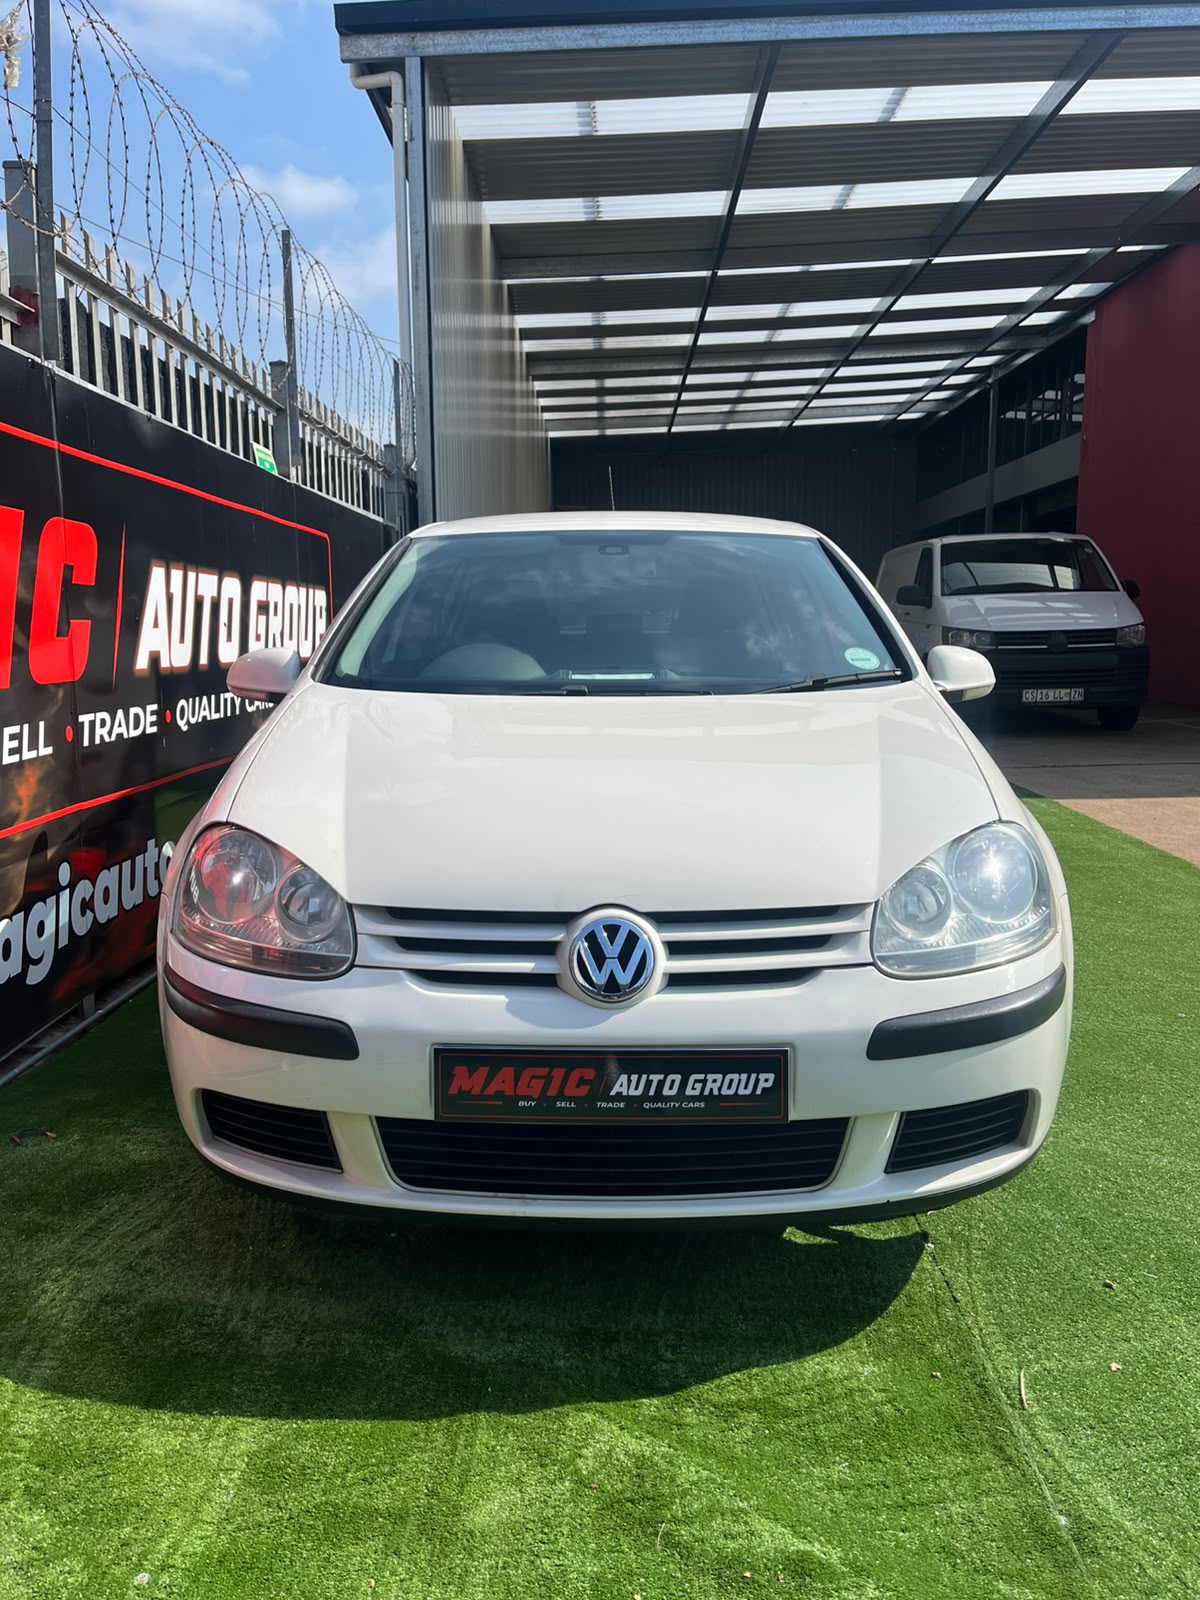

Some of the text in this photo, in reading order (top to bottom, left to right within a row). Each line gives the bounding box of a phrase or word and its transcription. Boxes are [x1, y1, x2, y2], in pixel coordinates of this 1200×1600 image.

[135, 565, 241, 670] AUTO
[250, 579, 327, 660] GROUP
[1039, 690, 1050, 700] 16
[78, 704, 158, 747] TRADE
[176, 692, 242, 732] QUALITY
[609, 1073, 682, 1096] AUTO
[685, 1073, 775, 1095] GROUP
[643, 1101, 682, 1109] QUALITY
[682, 1101, 706, 1109] CARS
